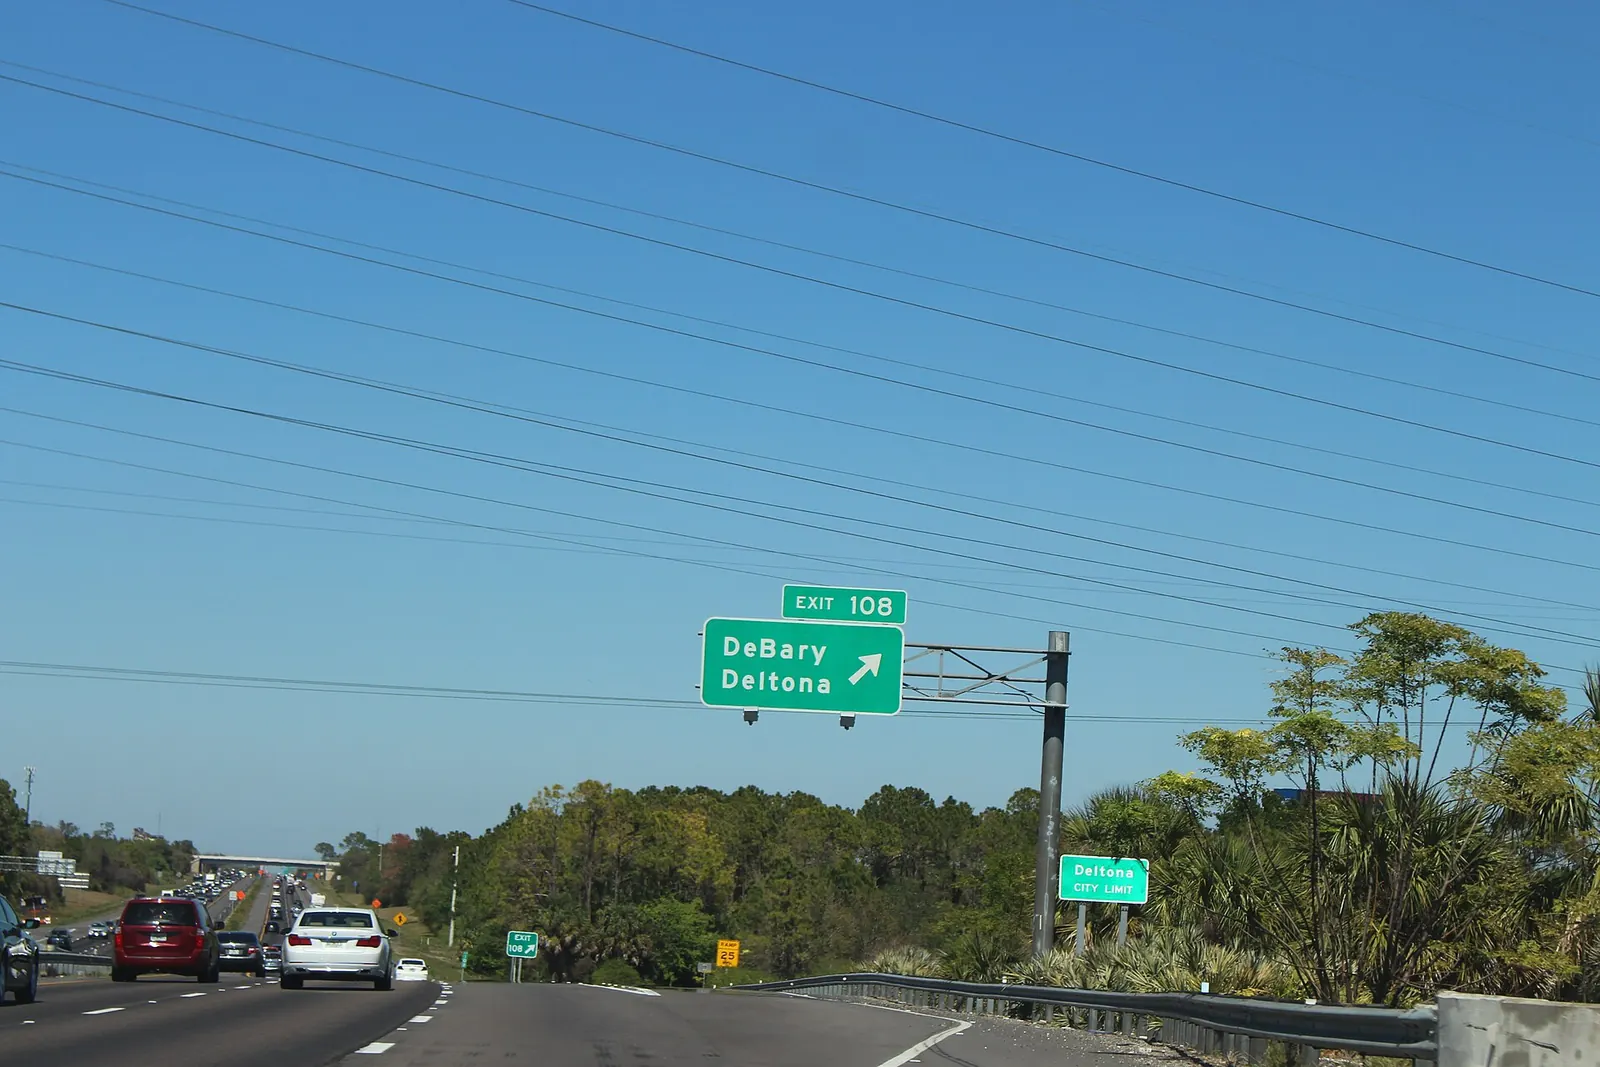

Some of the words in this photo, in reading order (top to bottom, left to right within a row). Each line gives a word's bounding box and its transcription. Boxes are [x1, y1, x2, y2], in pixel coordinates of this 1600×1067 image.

[796, 595, 834, 610] EXIT
[850, 596, 893, 617] 108
[723, 636, 827, 666] DeBary
[722, 669, 831, 694] Deltona
[1074, 864, 1134, 879] Deltona
[1074, 883, 1099, 893] CITY
[1104, 884, 1133, 895] LIMIT
[514, 934, 532, 942] EXIT
[508, 944, 523, 953] 108
[720, 951, 735, 960] 25
